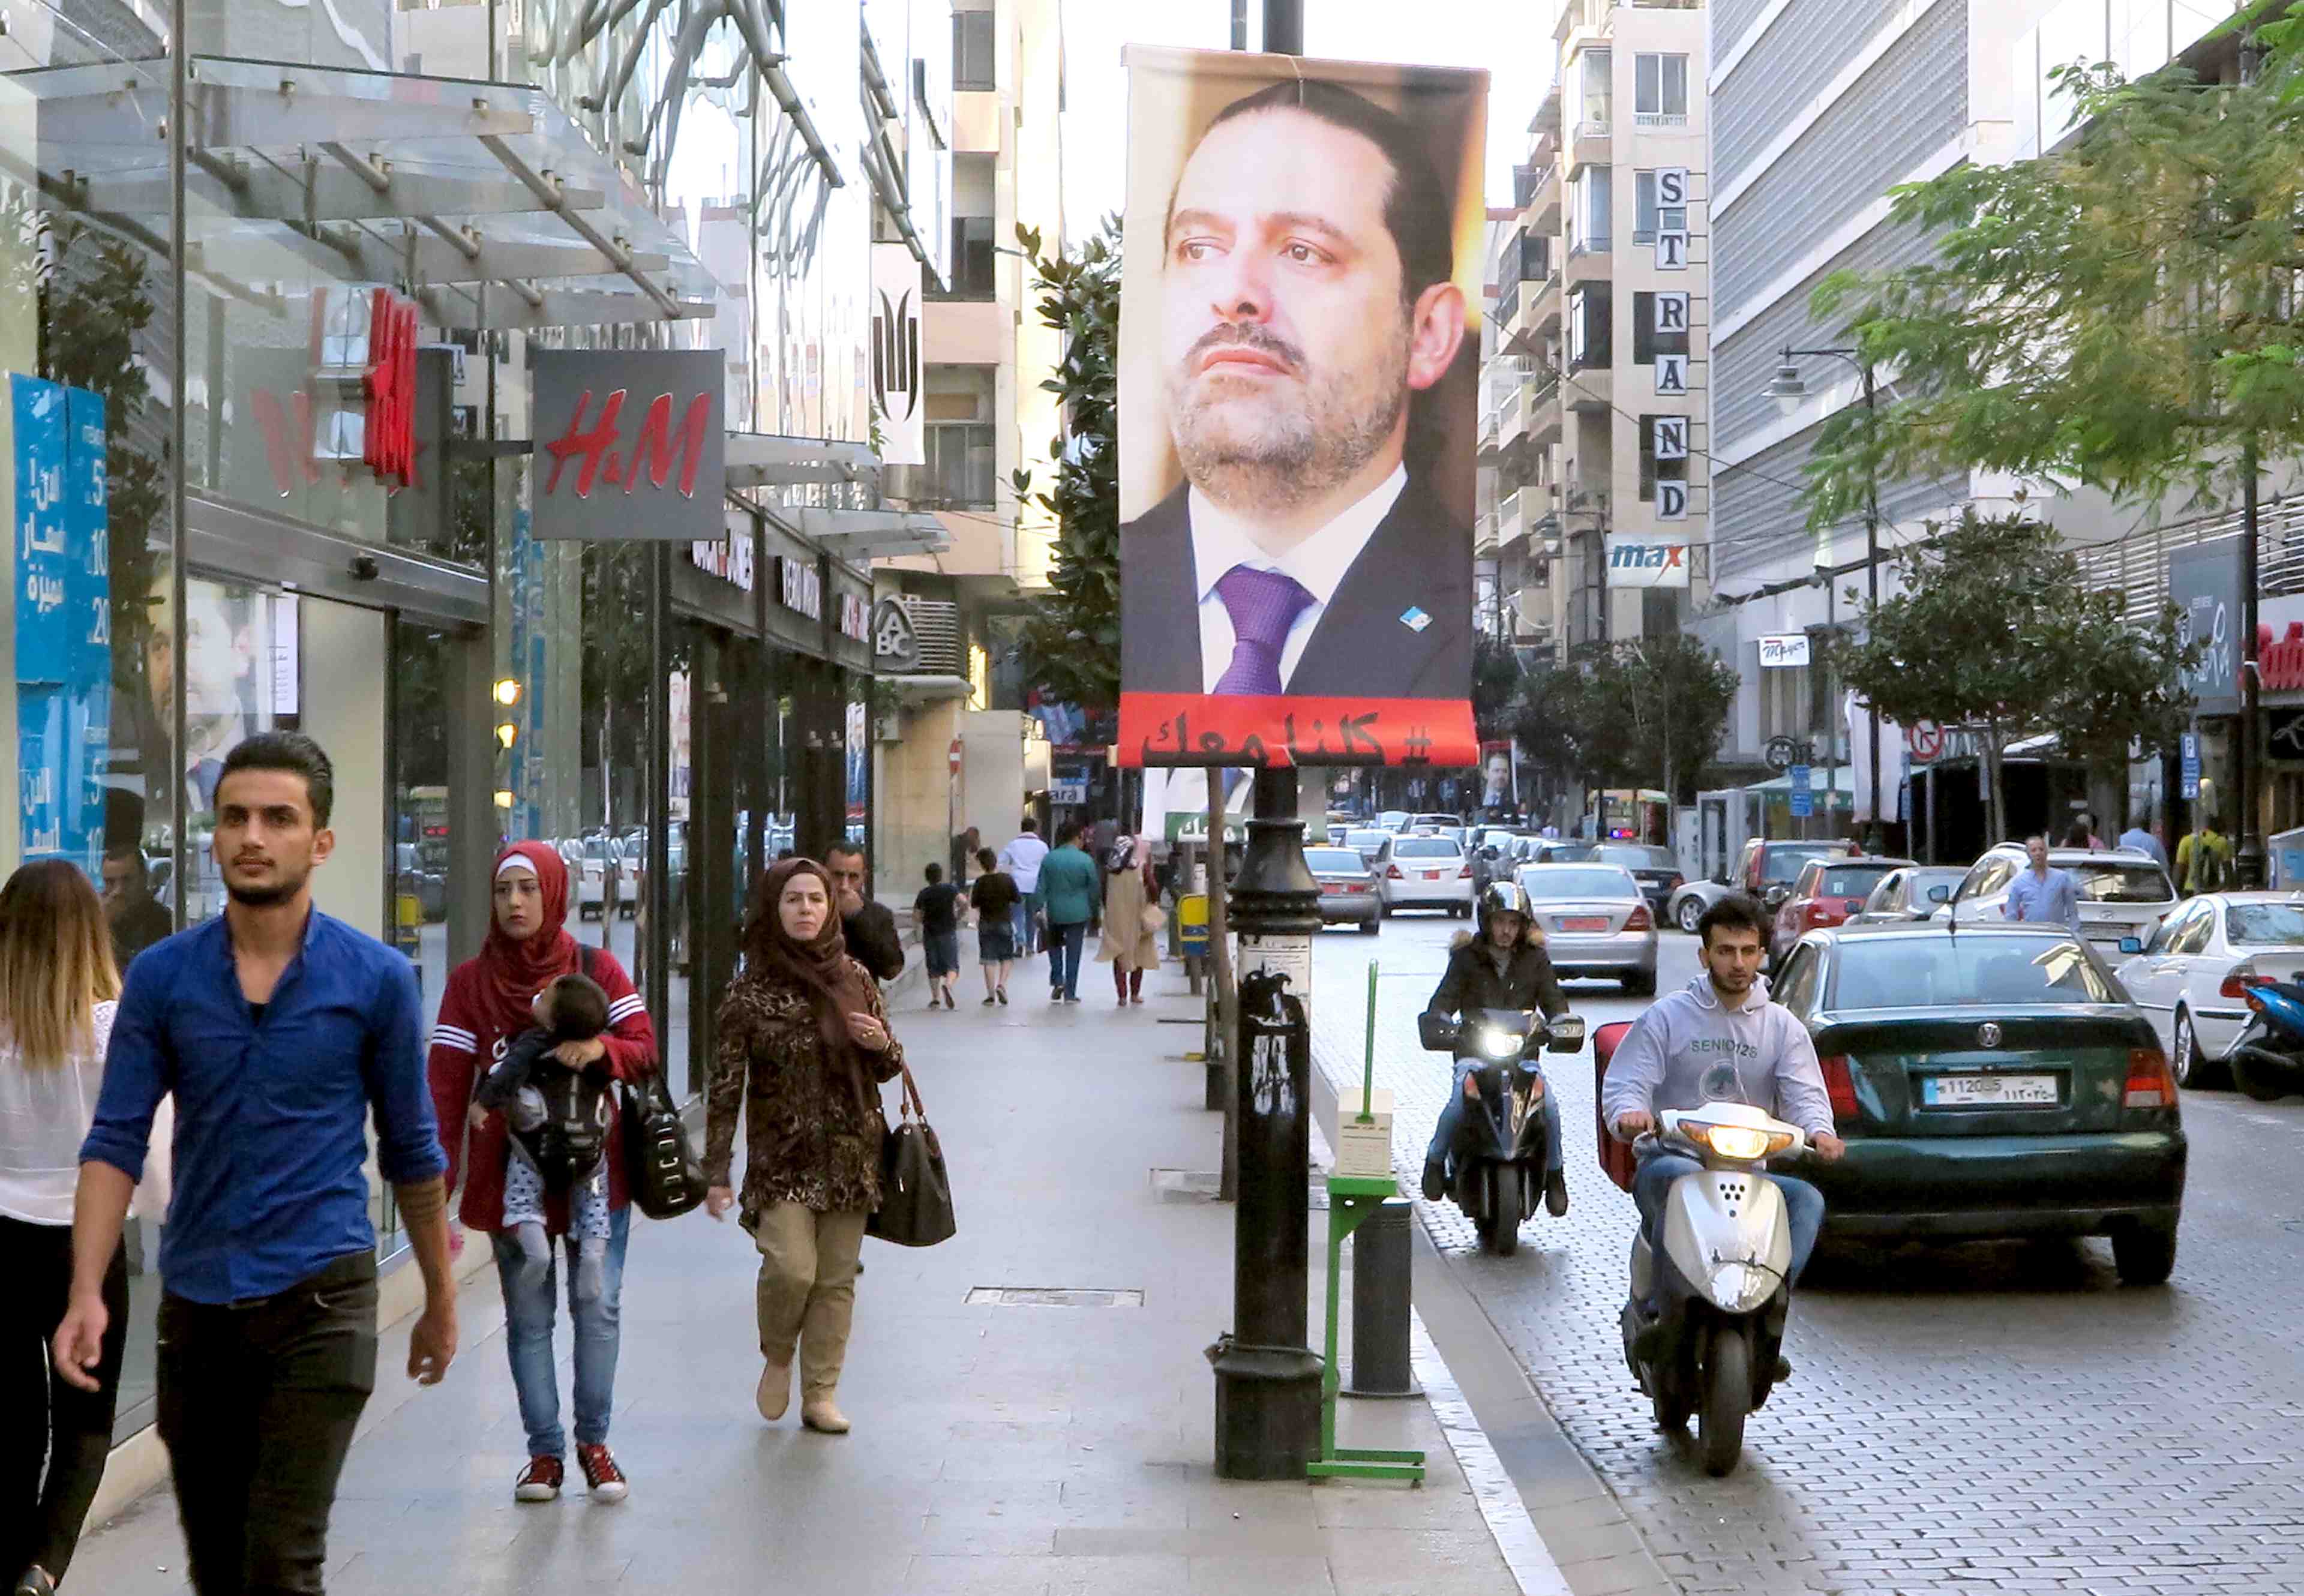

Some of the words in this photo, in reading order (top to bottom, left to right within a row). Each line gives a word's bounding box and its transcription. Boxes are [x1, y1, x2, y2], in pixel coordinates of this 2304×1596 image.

[1658, 172, 1685, 517] STRAND
[546, 389, 712, 499] H&M
[1611, 544, 1684, 584] max
